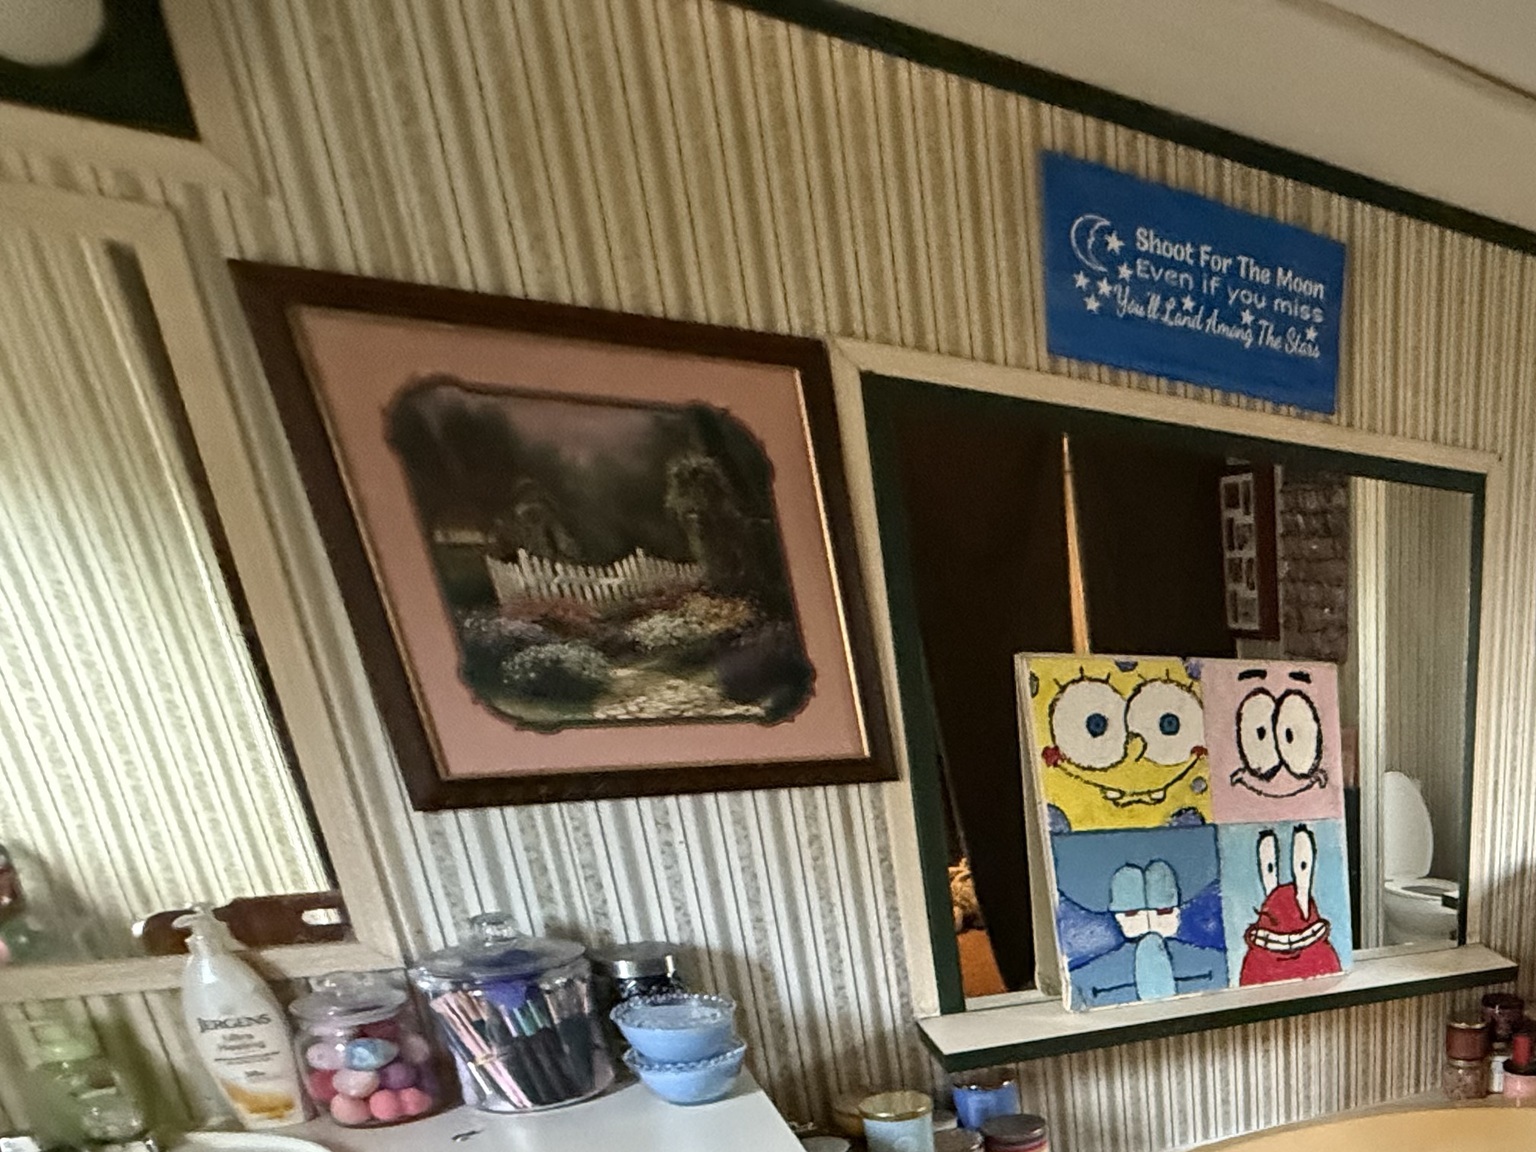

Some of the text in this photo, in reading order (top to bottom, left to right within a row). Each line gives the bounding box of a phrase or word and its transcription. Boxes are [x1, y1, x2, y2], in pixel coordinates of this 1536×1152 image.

[1136, 227, 1325, 299] Shoot For The Moon
[1136, 258, 1324, 323] Even if you miss
[1114, 283, 1321, 358] You'll Land Among The Stars
[197, 1013, 272, 1033] JERGENS
